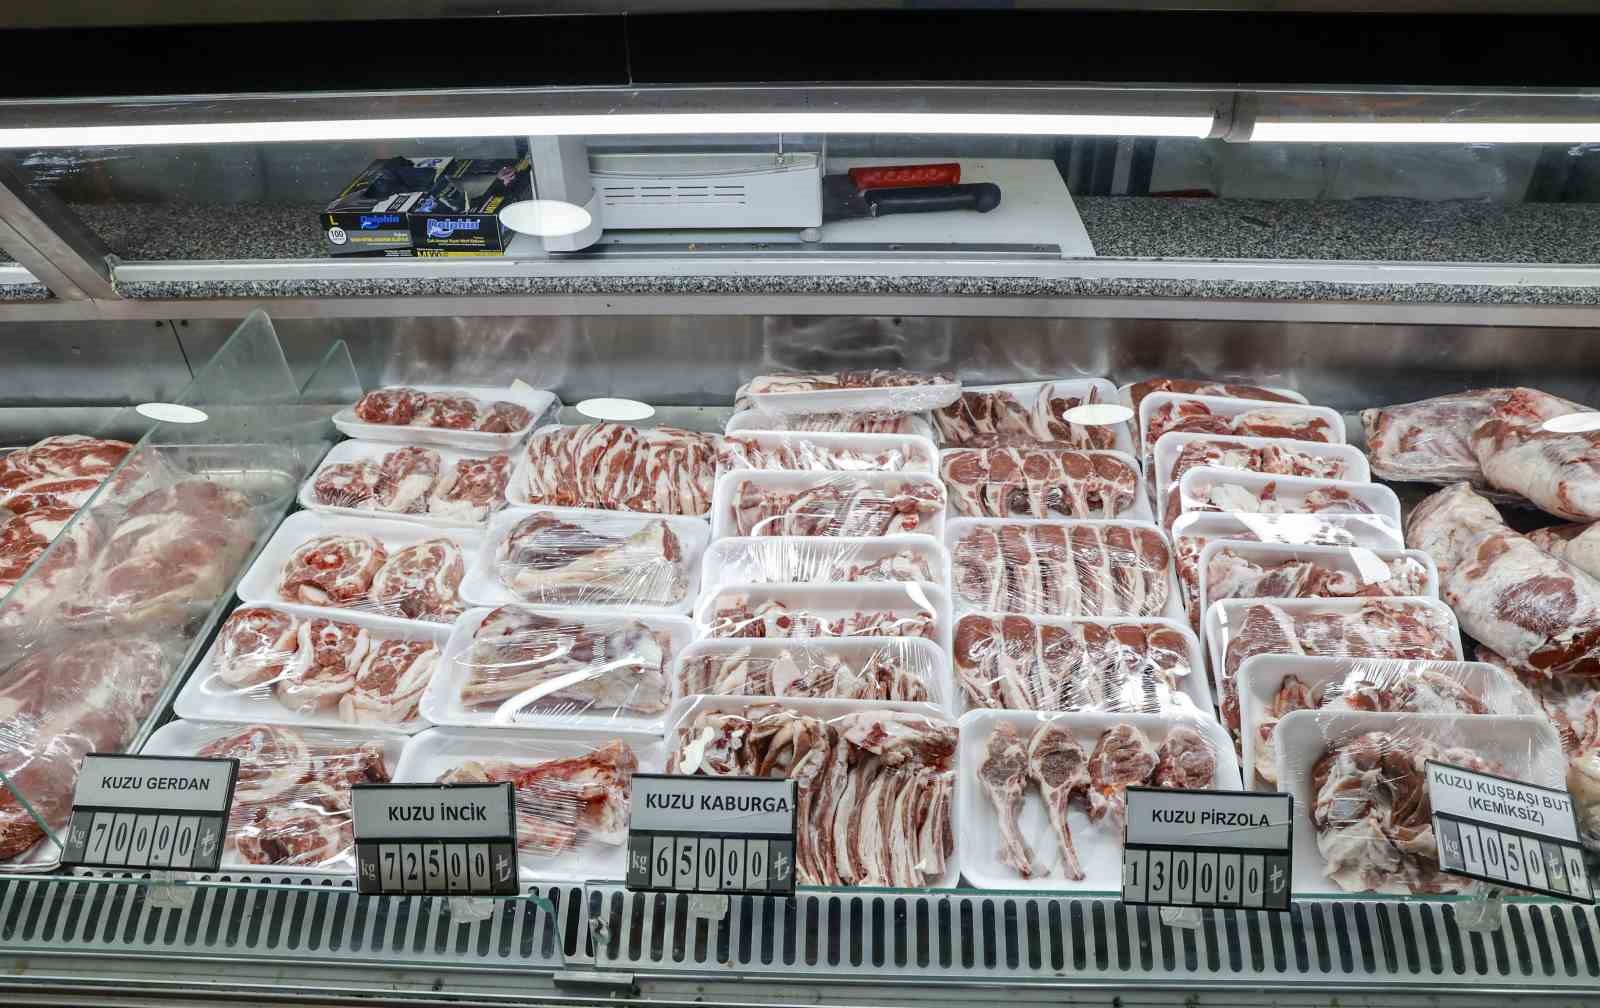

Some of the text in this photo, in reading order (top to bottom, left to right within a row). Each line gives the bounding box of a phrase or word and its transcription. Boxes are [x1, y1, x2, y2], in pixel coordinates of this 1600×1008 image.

[329, 214, 338, 225] L
[360, 214, 400, 226] Dolphin
[101, 776, 210, 791] KUZU GERDAN
[1434, 771, 1473, 791] KUZU
[1542, 796, 1570, 813] BUT
[388, 802, 487, 821] KUZU İNCİK
[646, 793, 789, 813] KUZU KABURGA
[1468, 796, 1545, 826] (KEMİKSİZ)
[1152, 808, 1270, 827] KUZU PİRZOLA
[69, 825, 85, 849] kg
[1443, 833, 1458, 857] kg
[361, 859, 375, 880] kg
[631, 850, 647, 874] kg
